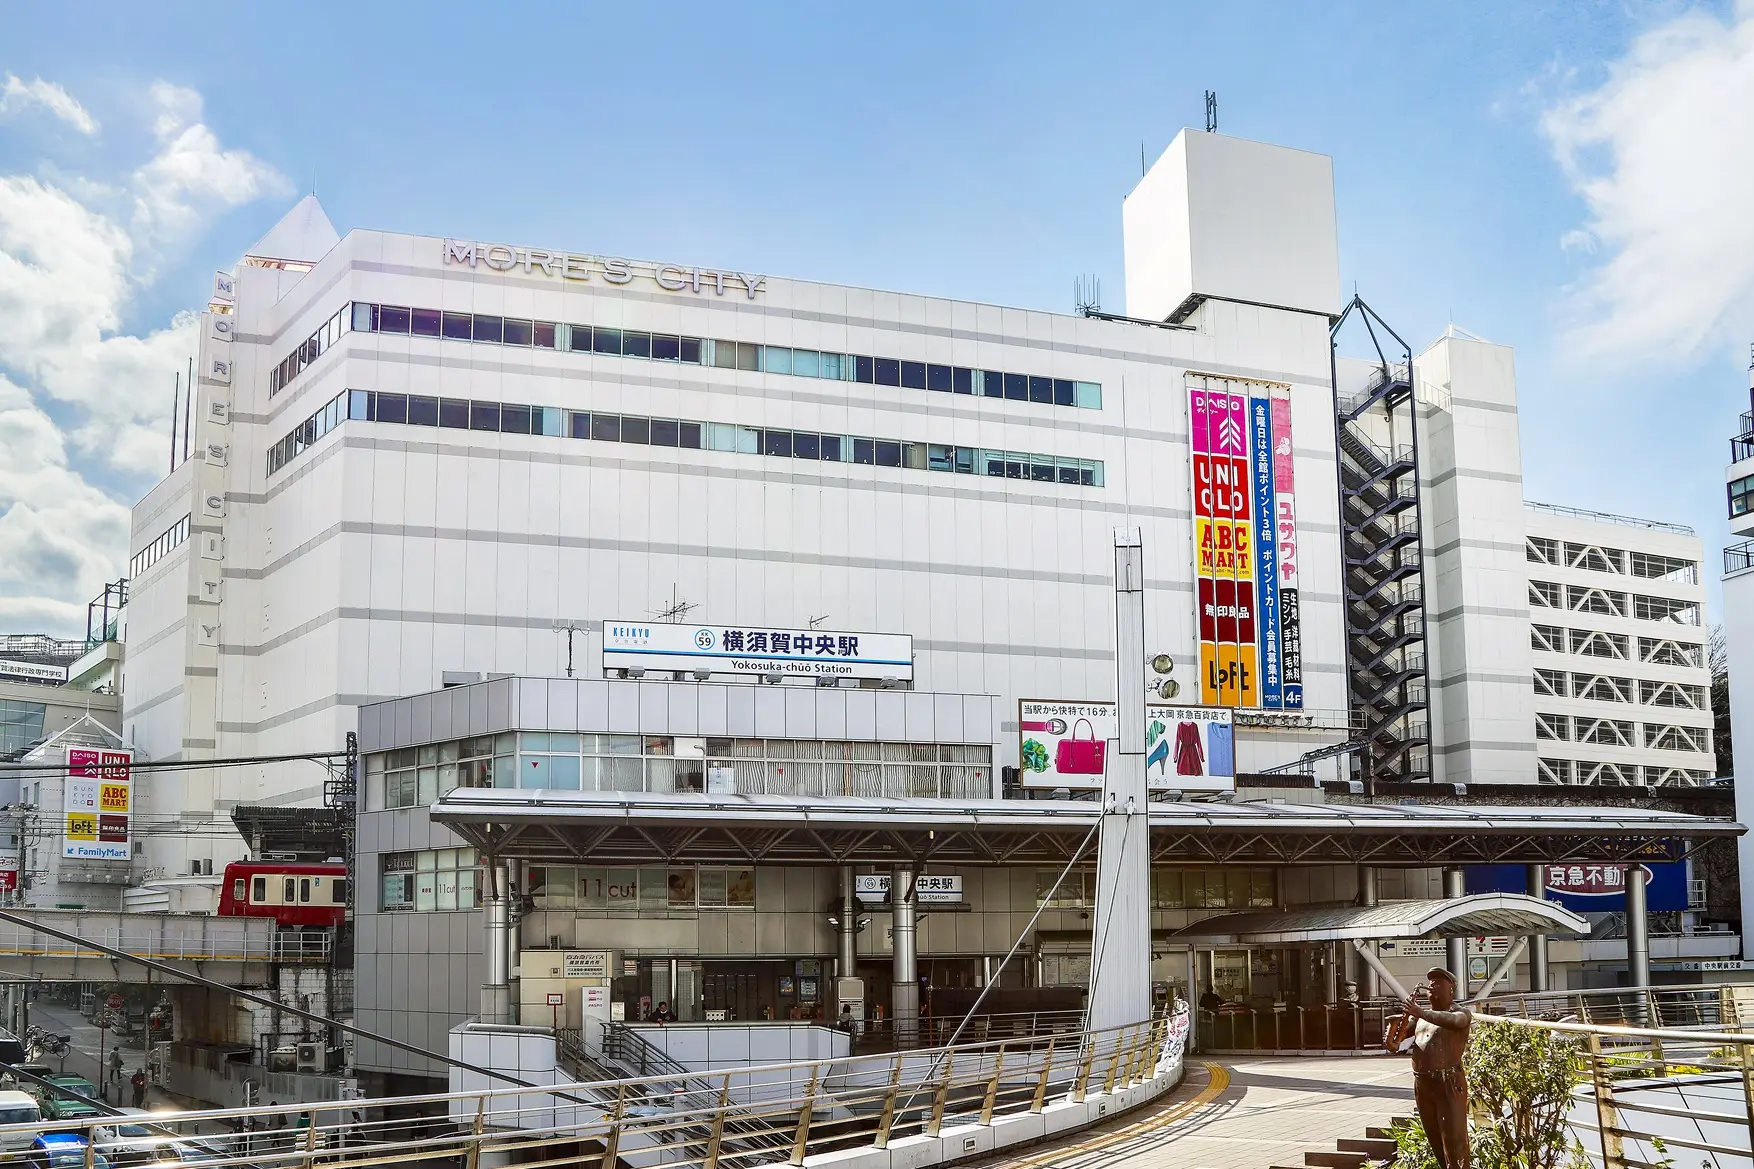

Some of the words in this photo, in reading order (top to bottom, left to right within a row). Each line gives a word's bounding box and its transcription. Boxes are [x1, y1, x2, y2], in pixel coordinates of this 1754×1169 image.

[443, 237, 634, 285] MORE'S
[655, 262, 767, 300] CITY
[1195, 396, 1240, 411] DAISO
[1199, 462, 1239, 487] UNI
[1200, 488, 1243, 514] QLO
[1201, 523, 1248, 551] ABC
[202, 495, 222, 638] CITY
[1201, 550, 1249, 569] MART
[1204, 603, 1250, 619] 無印良品
[613, 627, 650, 638] KEIKYU
[698, 636, 712, 647] 59
[722, 630, 859, 657] 横須賀中央駅
[814, 662, 853, 675] Station
[1285, 690, 1302, 704] 4F
[1147, 709, 1175, 720] 上大岡
[103, 786, 127, 799] ABC
[102, 798, 127, 807] MART
[78, 847, 127, 858] FamilyMart
[1548, 866, 1626, 887] 京急不動
